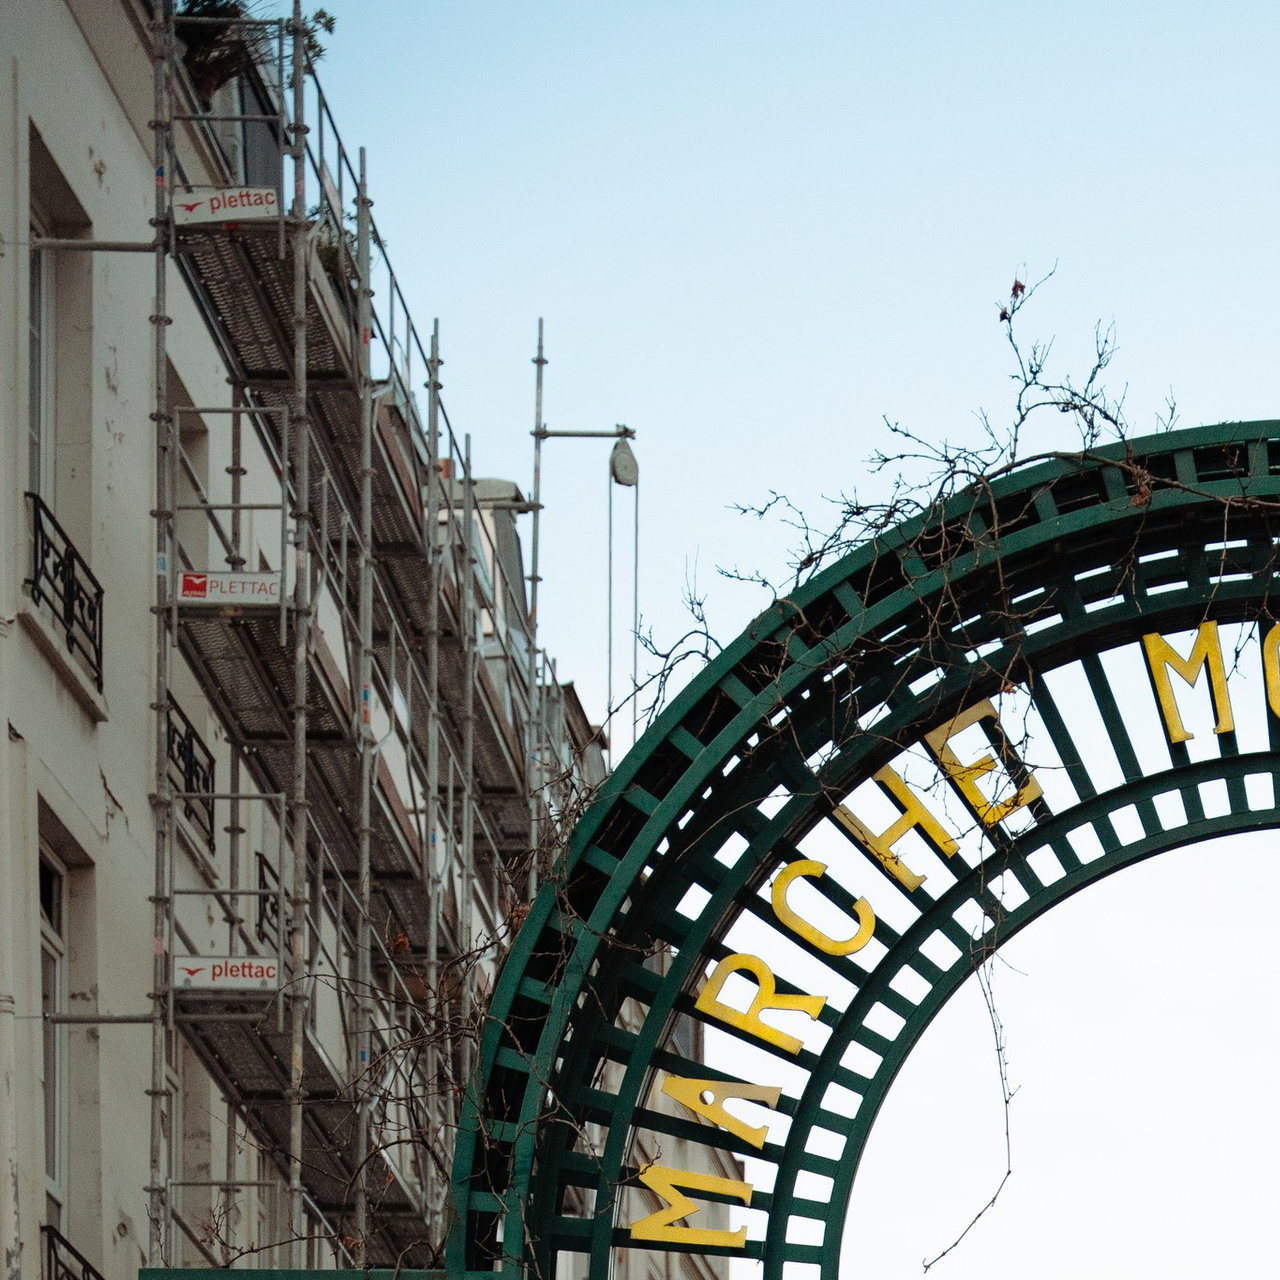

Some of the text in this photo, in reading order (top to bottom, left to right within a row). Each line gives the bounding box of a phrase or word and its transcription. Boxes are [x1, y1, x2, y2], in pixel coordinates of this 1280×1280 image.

[209, 189, 276, 215] plettac
[209, 580, 278, 595] PLETTAC
[211, 960, 277, 981] plettac
[629, 696, 1045, 1250] MARCHE
